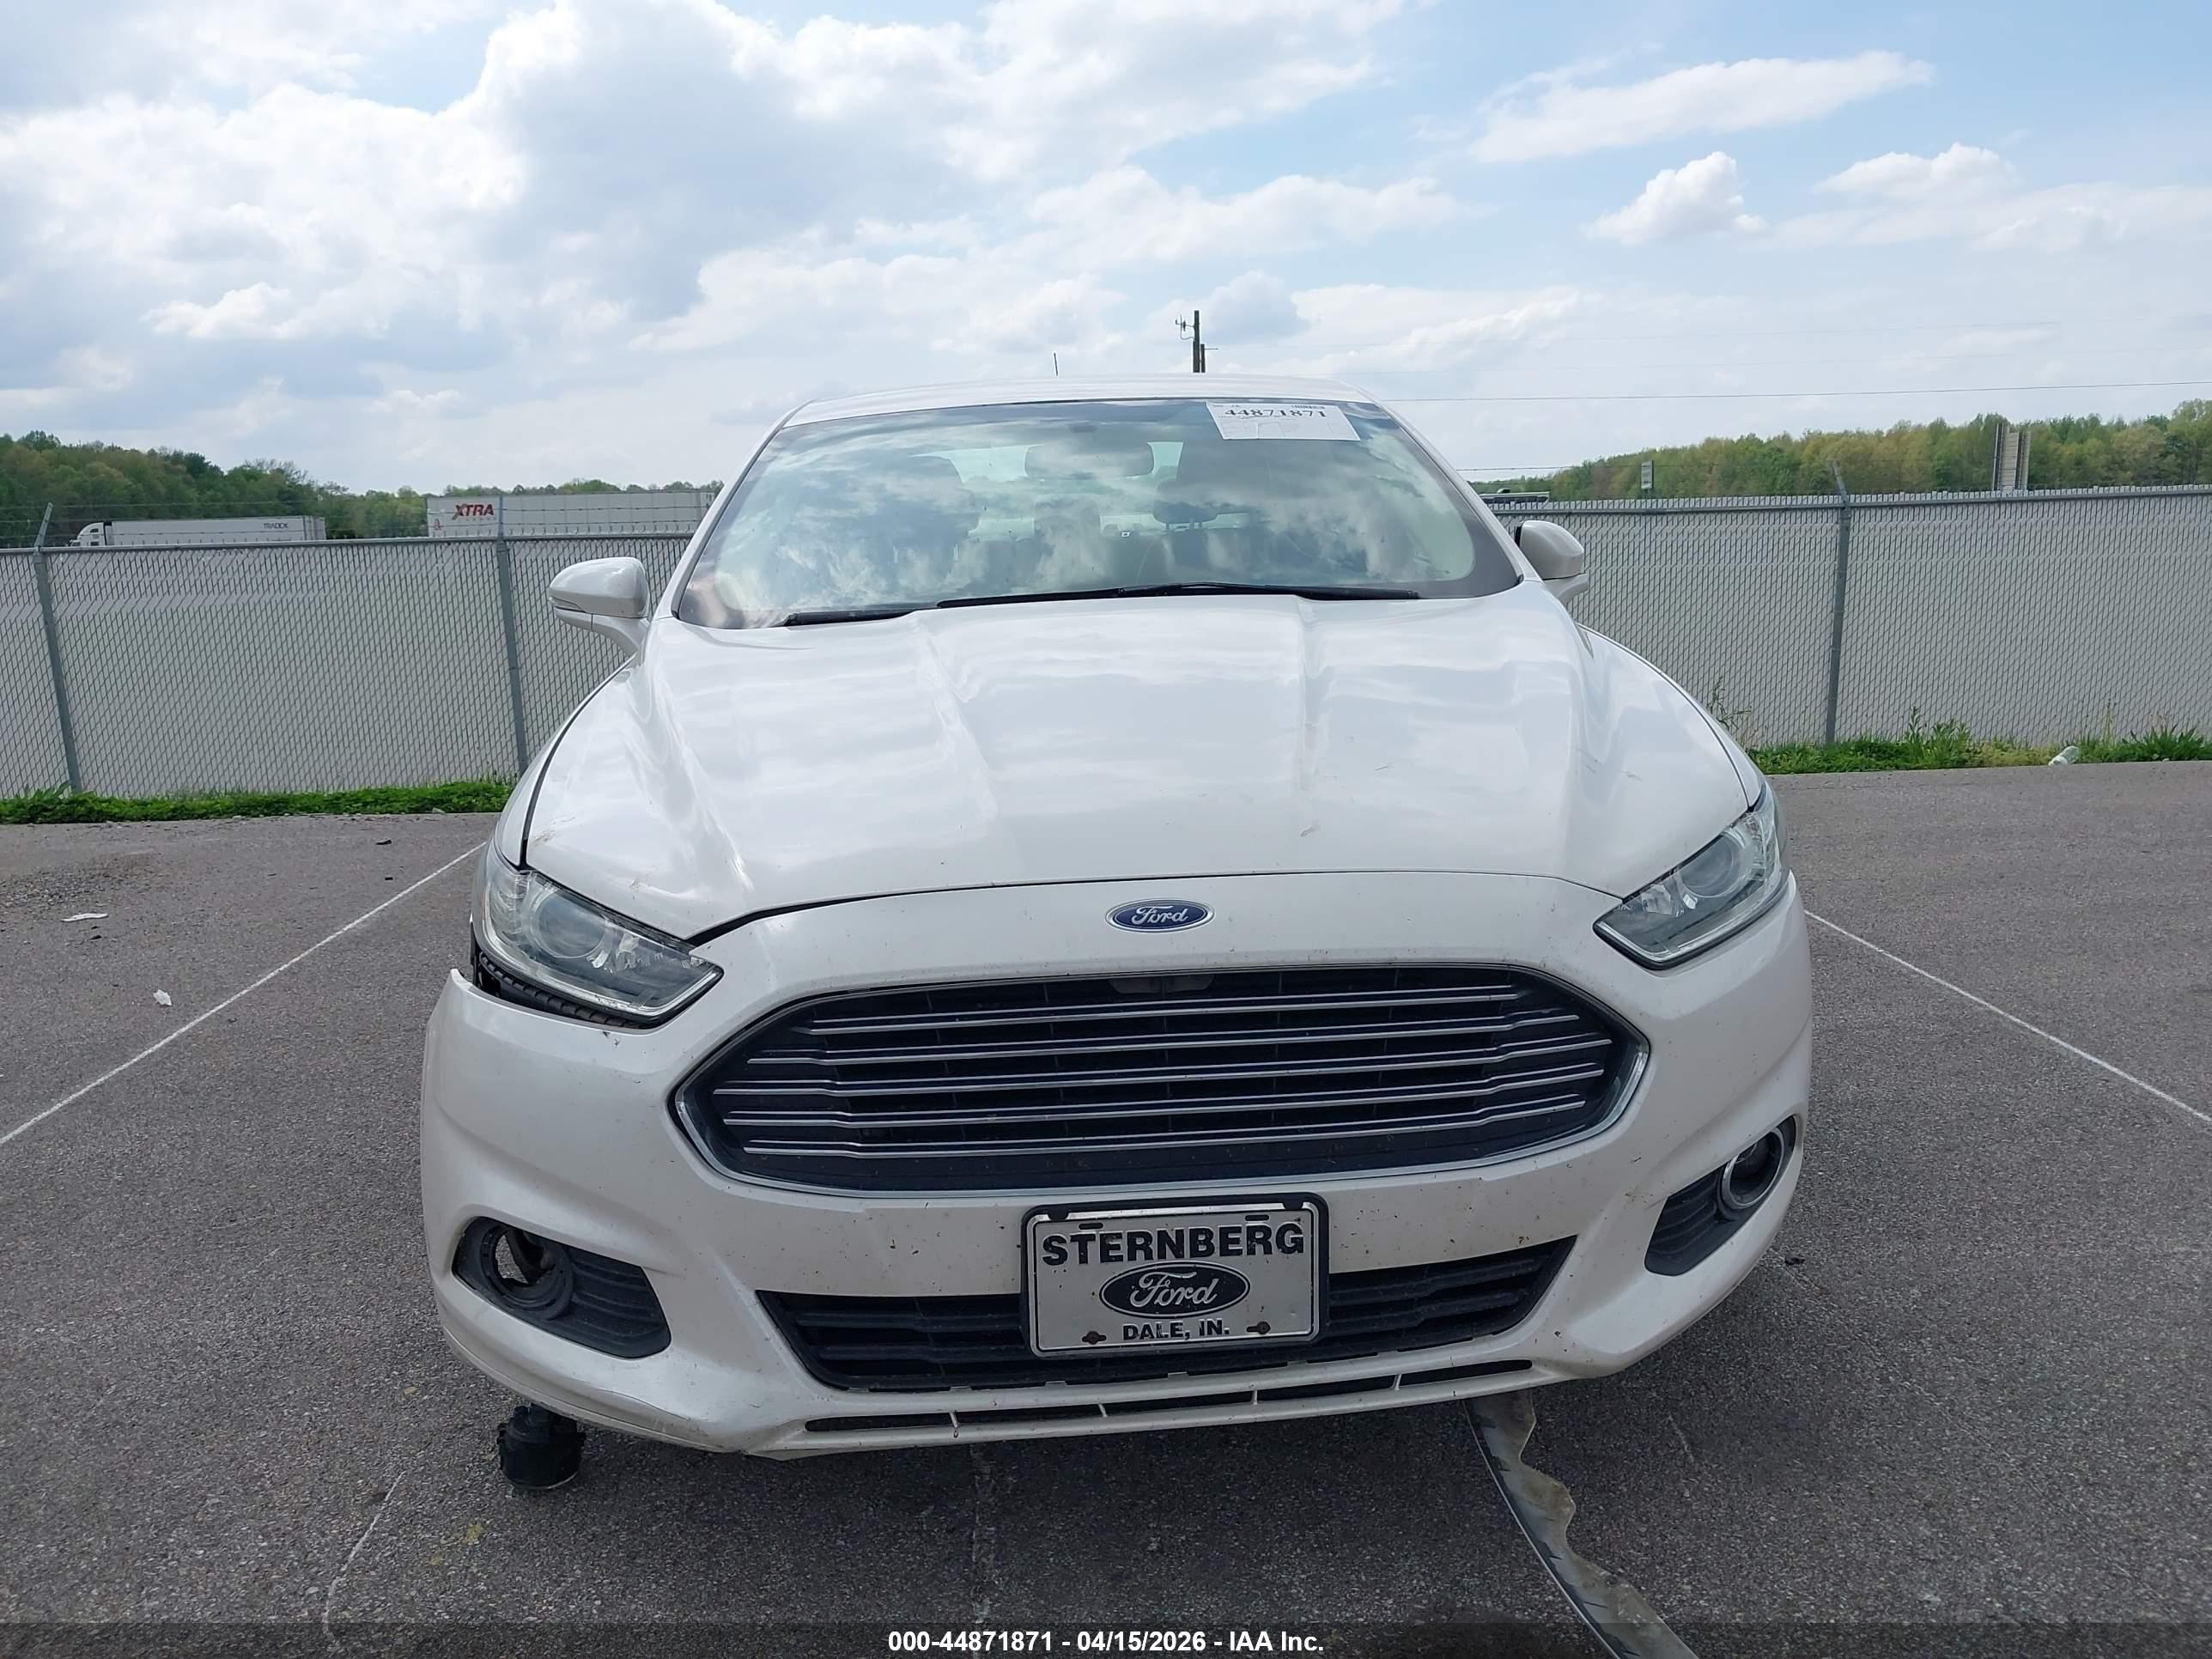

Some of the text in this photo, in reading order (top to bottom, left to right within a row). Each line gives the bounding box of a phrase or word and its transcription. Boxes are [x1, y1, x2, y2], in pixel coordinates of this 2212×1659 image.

[1224, 409, 1327, 418] 44871871
[452, 503, 495, 520] XTRA
[1131, 905, 1188, 925] Ford
[1042, 1222, 1304, 1267] STERNBERG
[1129, 1271, 1219, 1308] Ford
[1122, 1318, 1231, 1340] DALE, IN.
